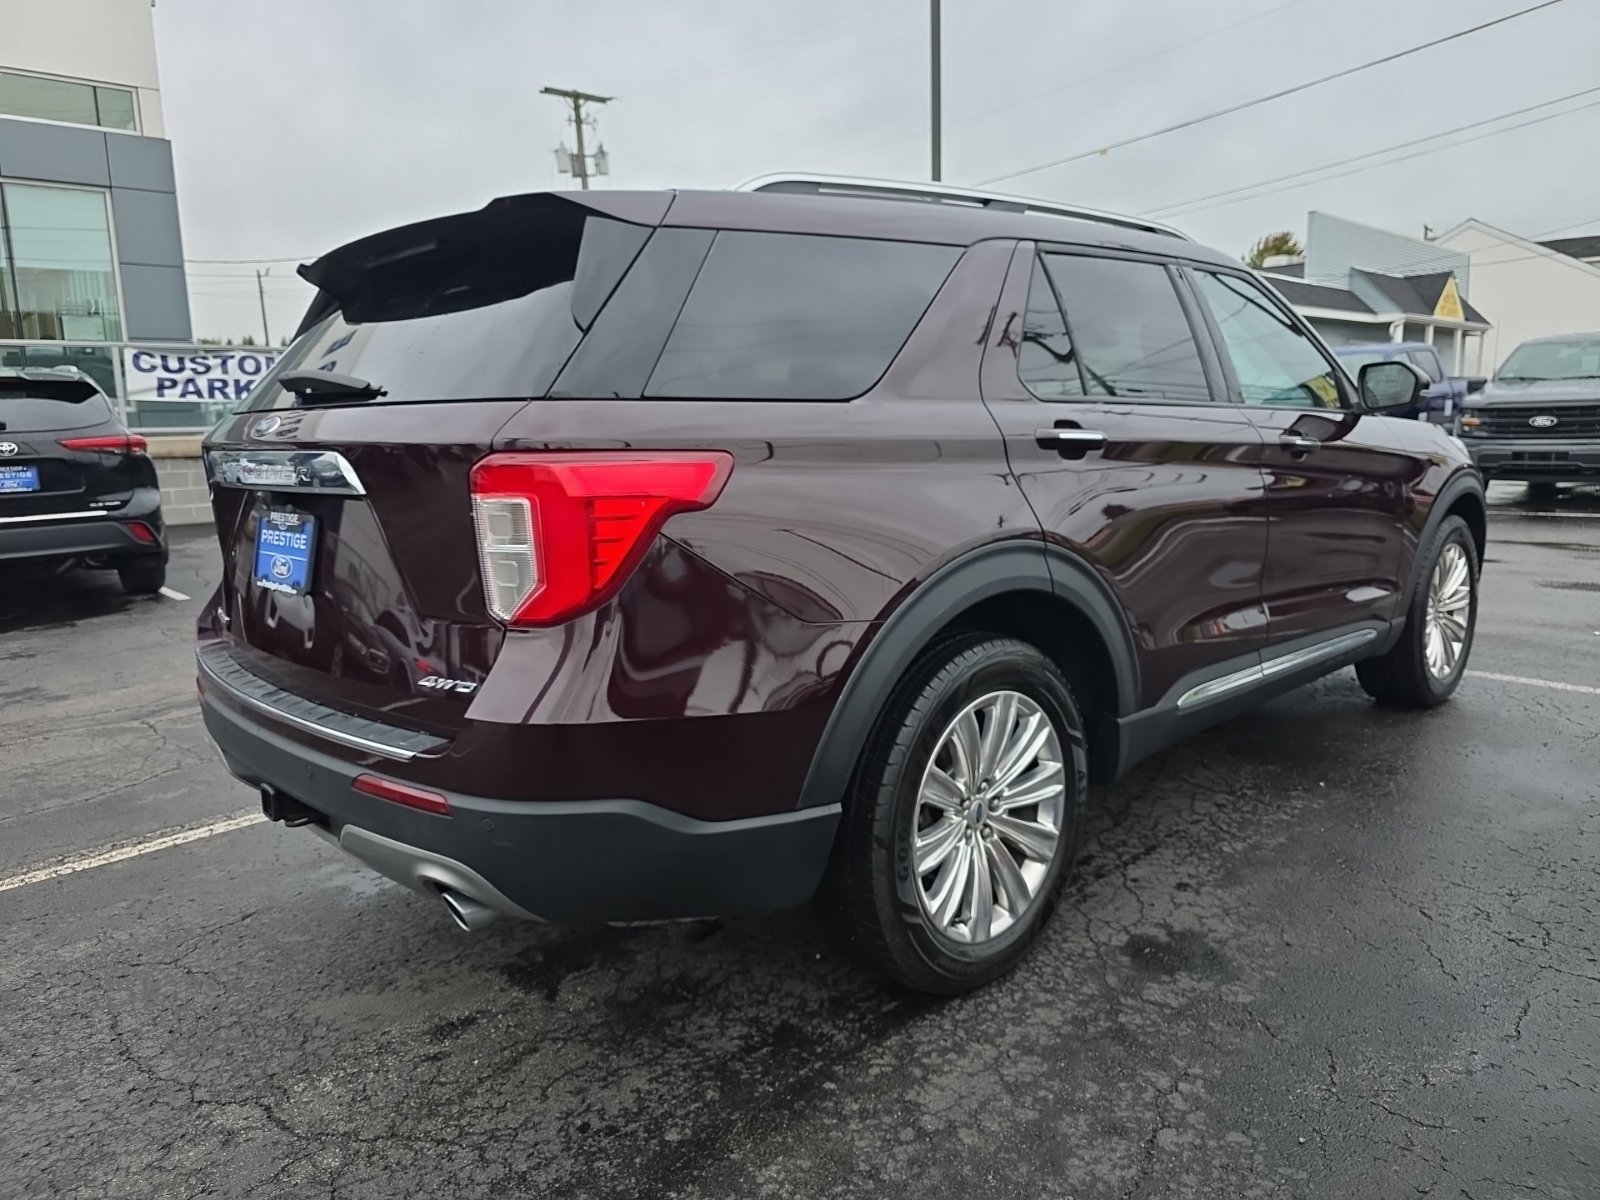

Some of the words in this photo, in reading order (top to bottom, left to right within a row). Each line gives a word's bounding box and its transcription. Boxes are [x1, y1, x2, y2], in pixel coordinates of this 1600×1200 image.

[270, 511, 300, 523] PRESTIGE
[261, 529, 308, 550] PRESTIGE
[417, 675, 478, 693] 4WD
